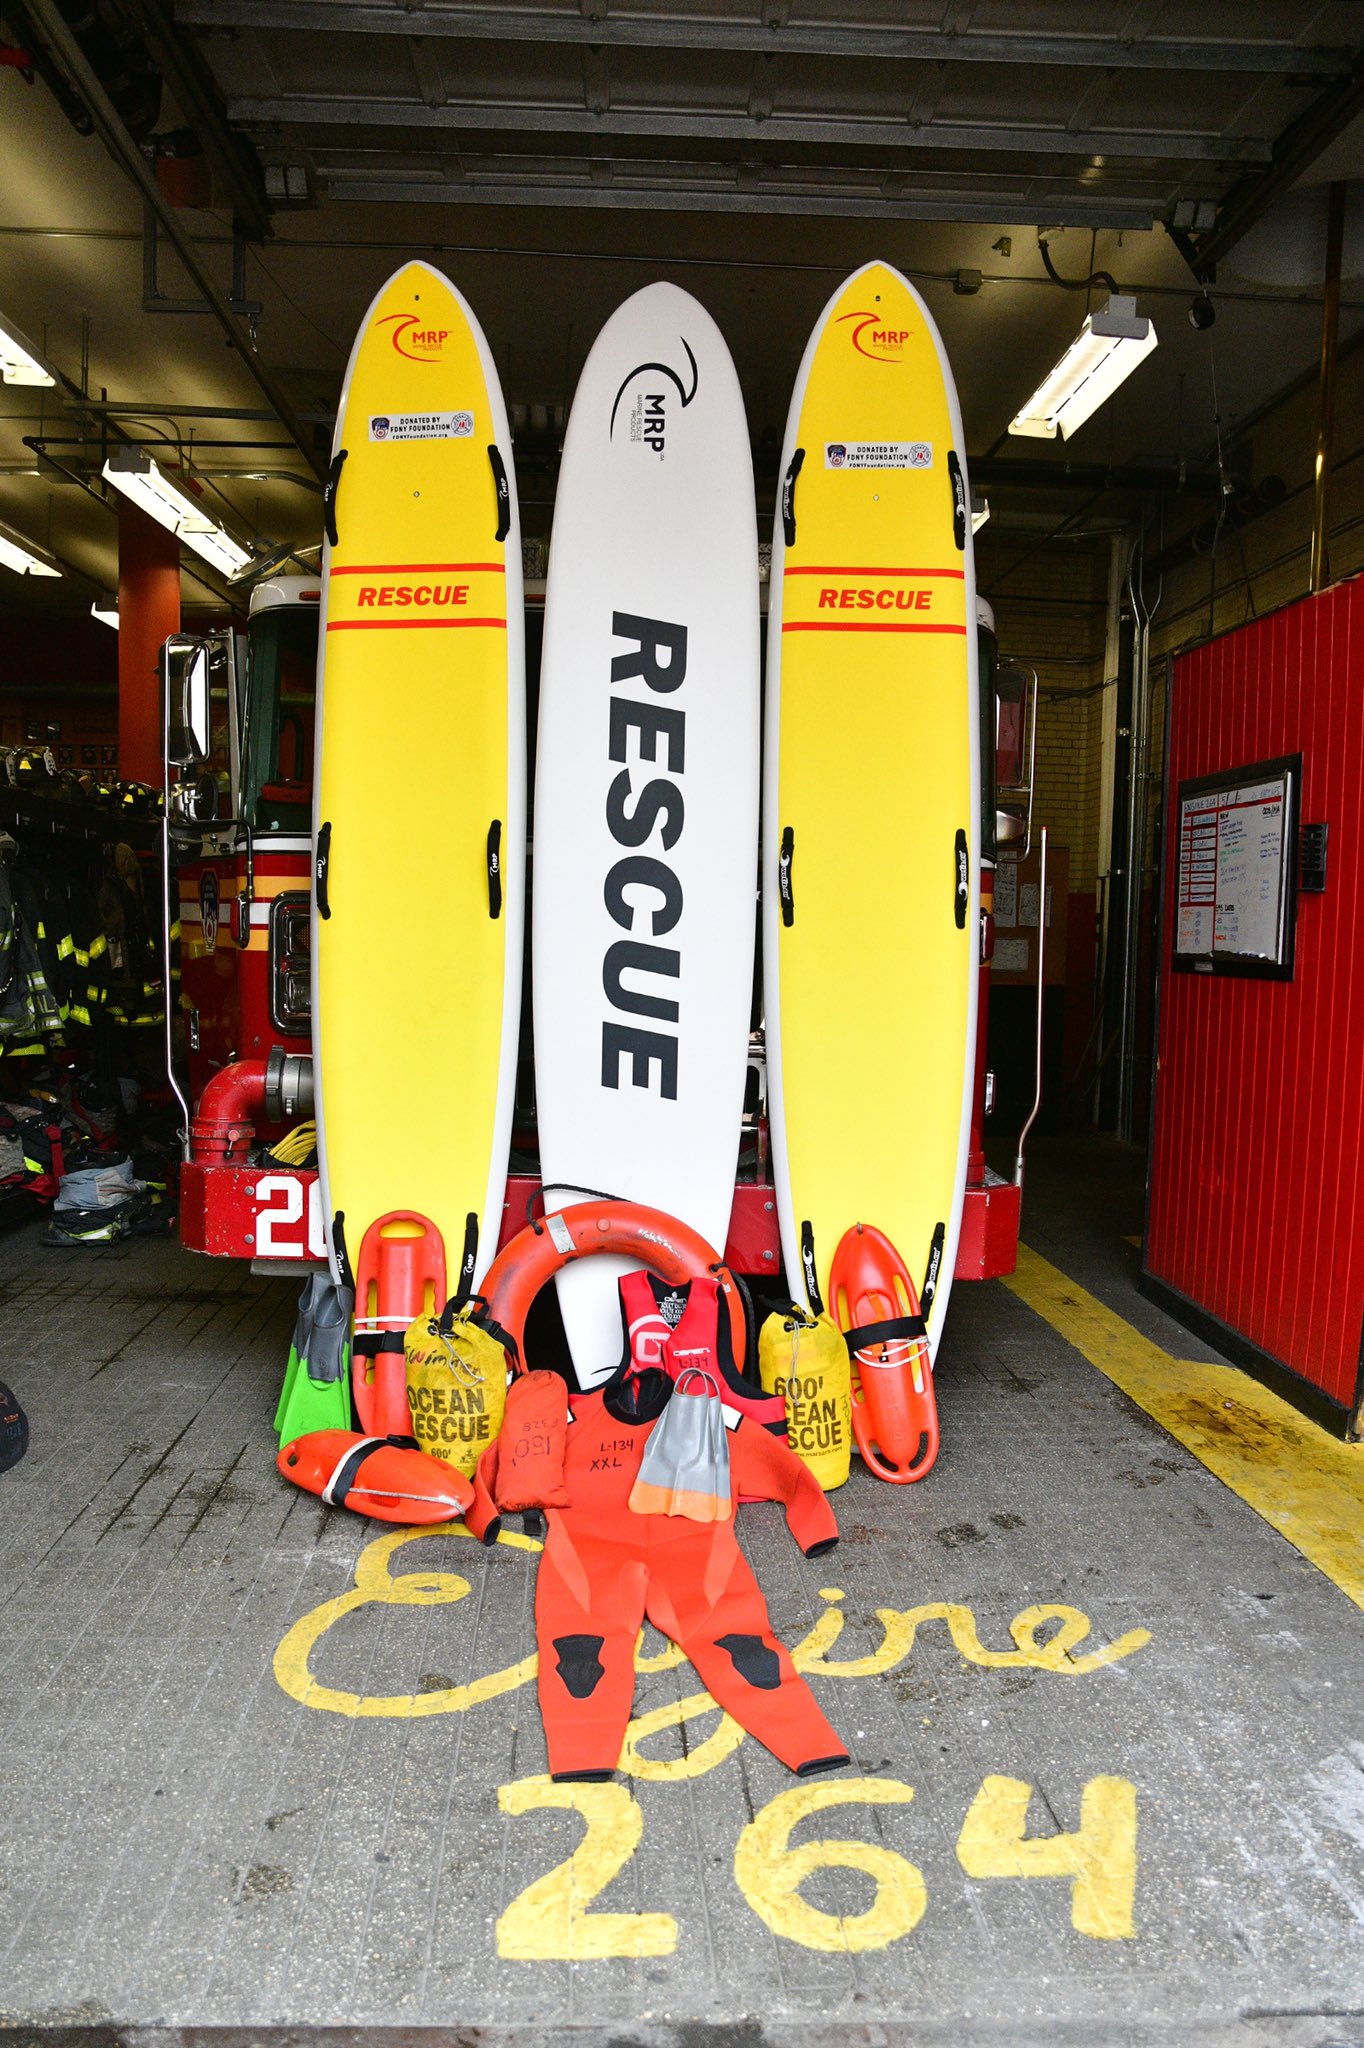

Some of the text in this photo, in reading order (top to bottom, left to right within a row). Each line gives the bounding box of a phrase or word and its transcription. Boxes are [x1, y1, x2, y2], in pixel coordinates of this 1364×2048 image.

[412, 331, 448, 344] MRP
[873, 331, 909, 344] MRP
[390, 425, 407, 433] FDNY
[409, 423, 451, 432] FOUNDATION
[400, 416, 441, 425] DONATED BY
[644, 395, 666, 453] MRP
[357, 585, 470, 607] RESCUE
[818, 588, 933, 610] RESCUE
[600, 610, 688, 1101] RESCUE
[406, 1385, 485, 1415] OCEAN
[785, 1398, 836, 1426] EAN
[414, 1413, 490, 1443] ESCUE
[787, 1421, 842, 1451] SCUE
[600, 1438, 634, 1452] L-134
[272, 1522, 1154, 1781] Eine
[496, 1773, 1139, 1961] 264
